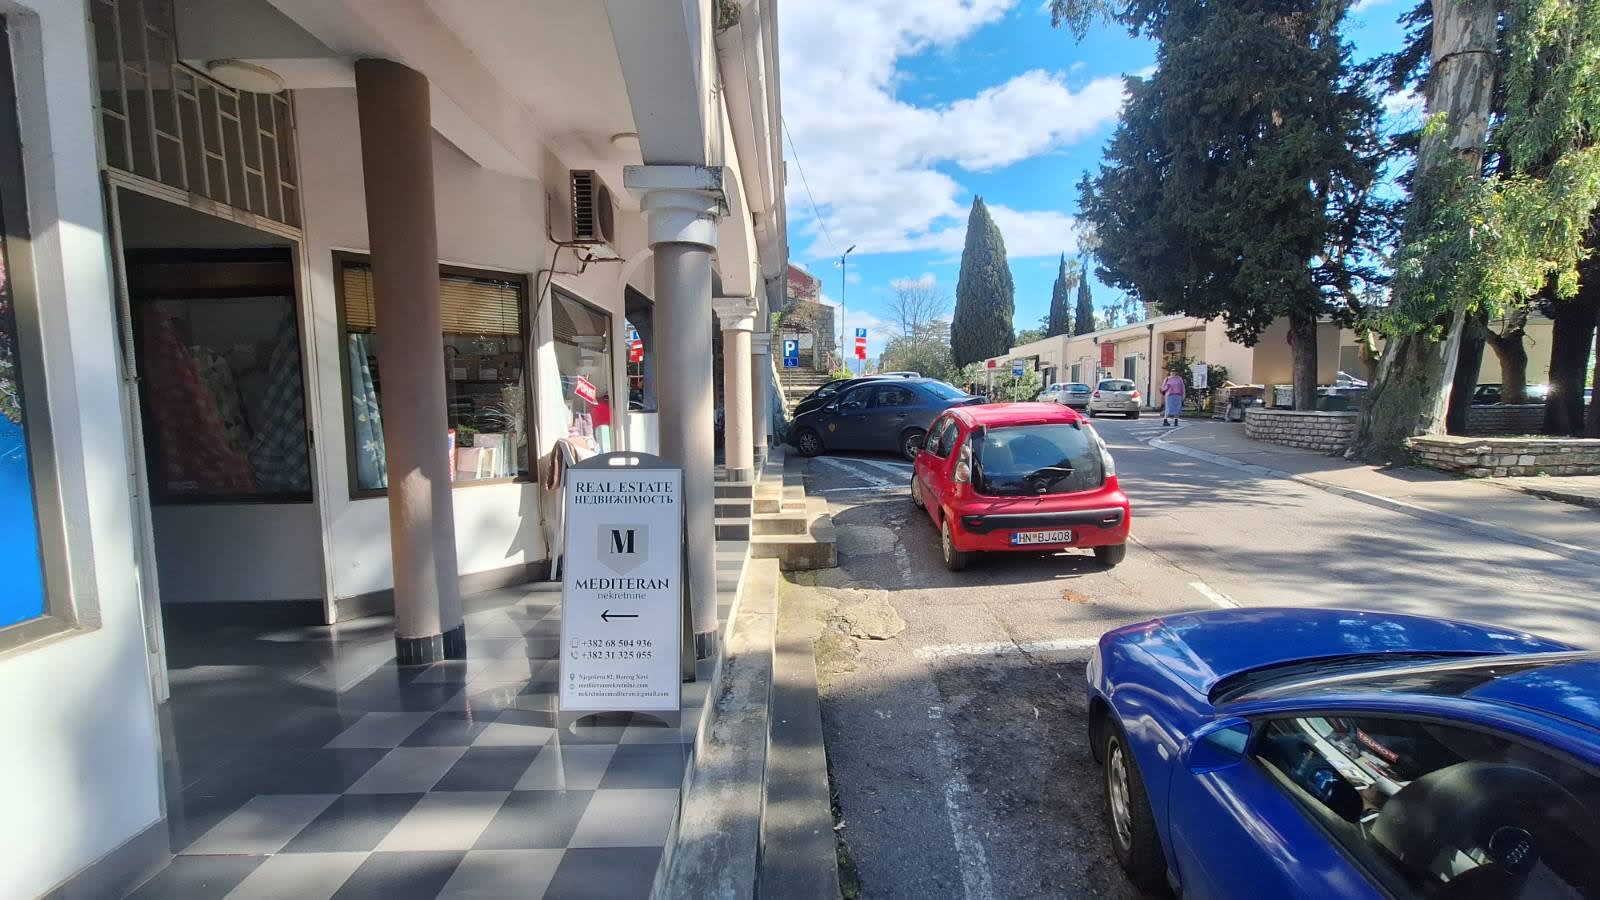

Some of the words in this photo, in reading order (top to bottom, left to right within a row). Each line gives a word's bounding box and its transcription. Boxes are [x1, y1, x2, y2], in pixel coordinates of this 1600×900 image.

[785, 340, 796, 357] P
[576, 481, 616, 493] REAL
[619, 481, 673, 493] ESTATE
[574, 495, 674, 505] НЕДВИЖИМОСТЬ
[609, 529, 636, 554] M
[1018, 532, 1032, 543] HN
[1038, 531, 1070, 542] BJ408
[574, 578, 669, 590] MEDITERAN
[597, 591, 647, 600] nekretnine
[582, 639, 603, 648] +382
[605, 639, 616, 648] 68
[618, 639, 634, 648] 504
[636, 639, 652, 648] 936
[582, 651, 603, 660] +382
[605, 651, 615, 660] 31
[618, 651, 634, 660] 325
[636, 651, 652, 660] 055
